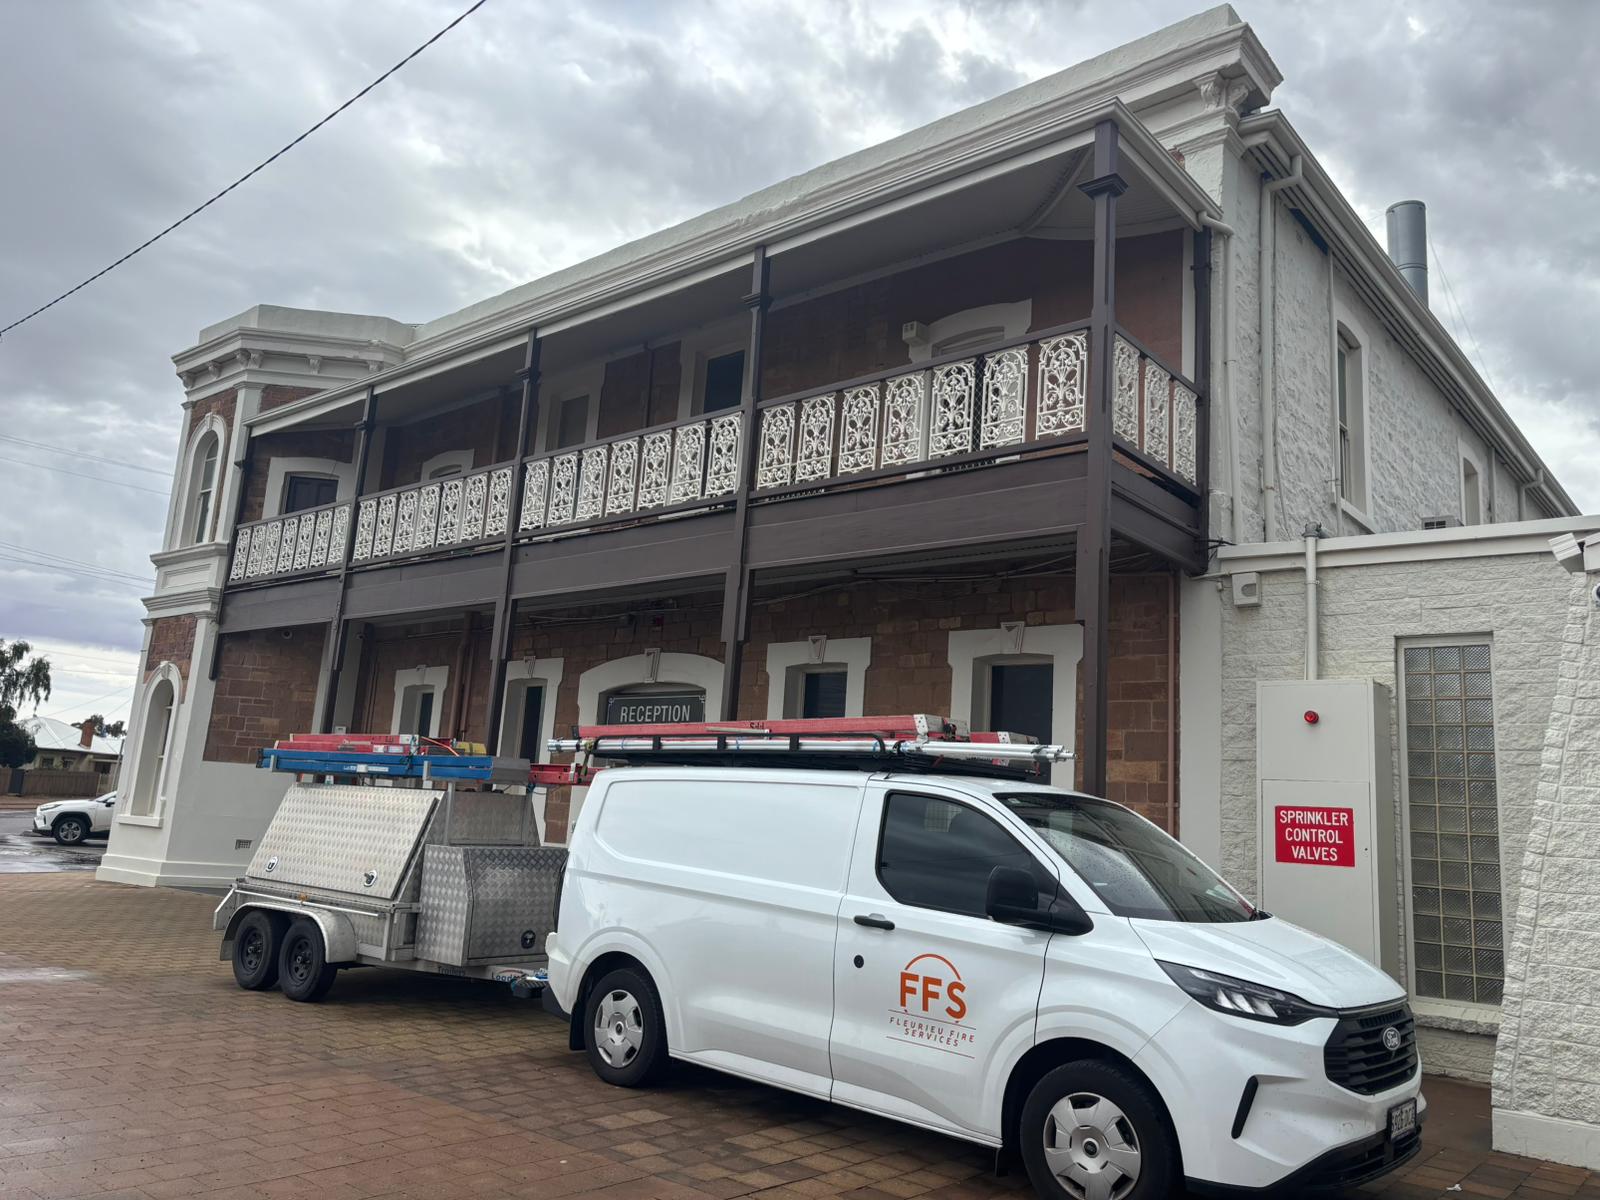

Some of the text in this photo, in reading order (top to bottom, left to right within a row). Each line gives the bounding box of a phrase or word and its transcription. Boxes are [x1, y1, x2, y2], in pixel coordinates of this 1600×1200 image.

[619, 704, 691, 723] RECEPTION
[1279, 810, 1349, 826] SPRINKLER
[1285, 827, 1344, 844] CONTROL
[1291, 845, 1338, 862] VALVES
[900, 971, 967, 1020] FFS
[889, 1016, 975, 1043] FLEURIEU FIRE
[904, 1027, 959, 1047] SERVICES
